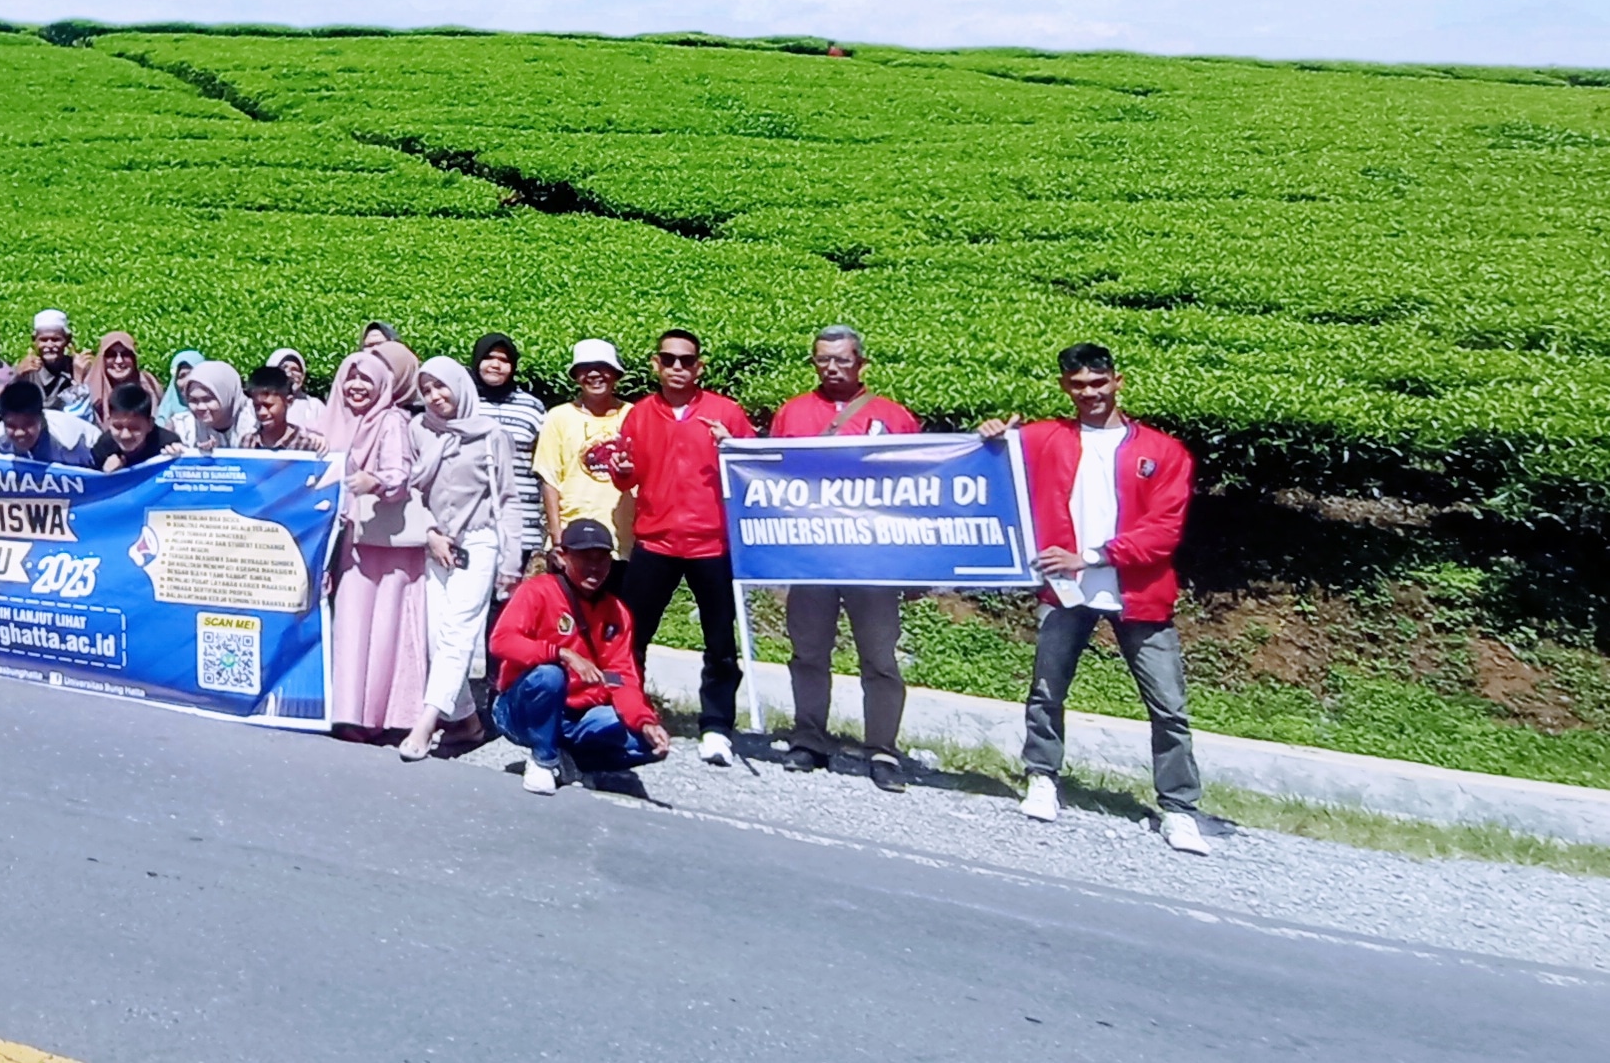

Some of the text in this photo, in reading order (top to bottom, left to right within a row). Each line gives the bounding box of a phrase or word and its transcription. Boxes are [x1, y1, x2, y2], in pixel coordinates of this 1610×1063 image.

[744, 475, 988, 509] AYO KULIAH DI
[740, 516, 1006, 546] UNIVERSITAS BUNG HATTA
[31, 552, 101, 598] 2023
[12, 608, 53, 625] LANJUT
[55, 613, 87, 629] LIHAT
[204, 617, 255, 629] SCAN ME!
[64, 677, 104, 691] Universitas
[104, 682, 124, 696] Bung
